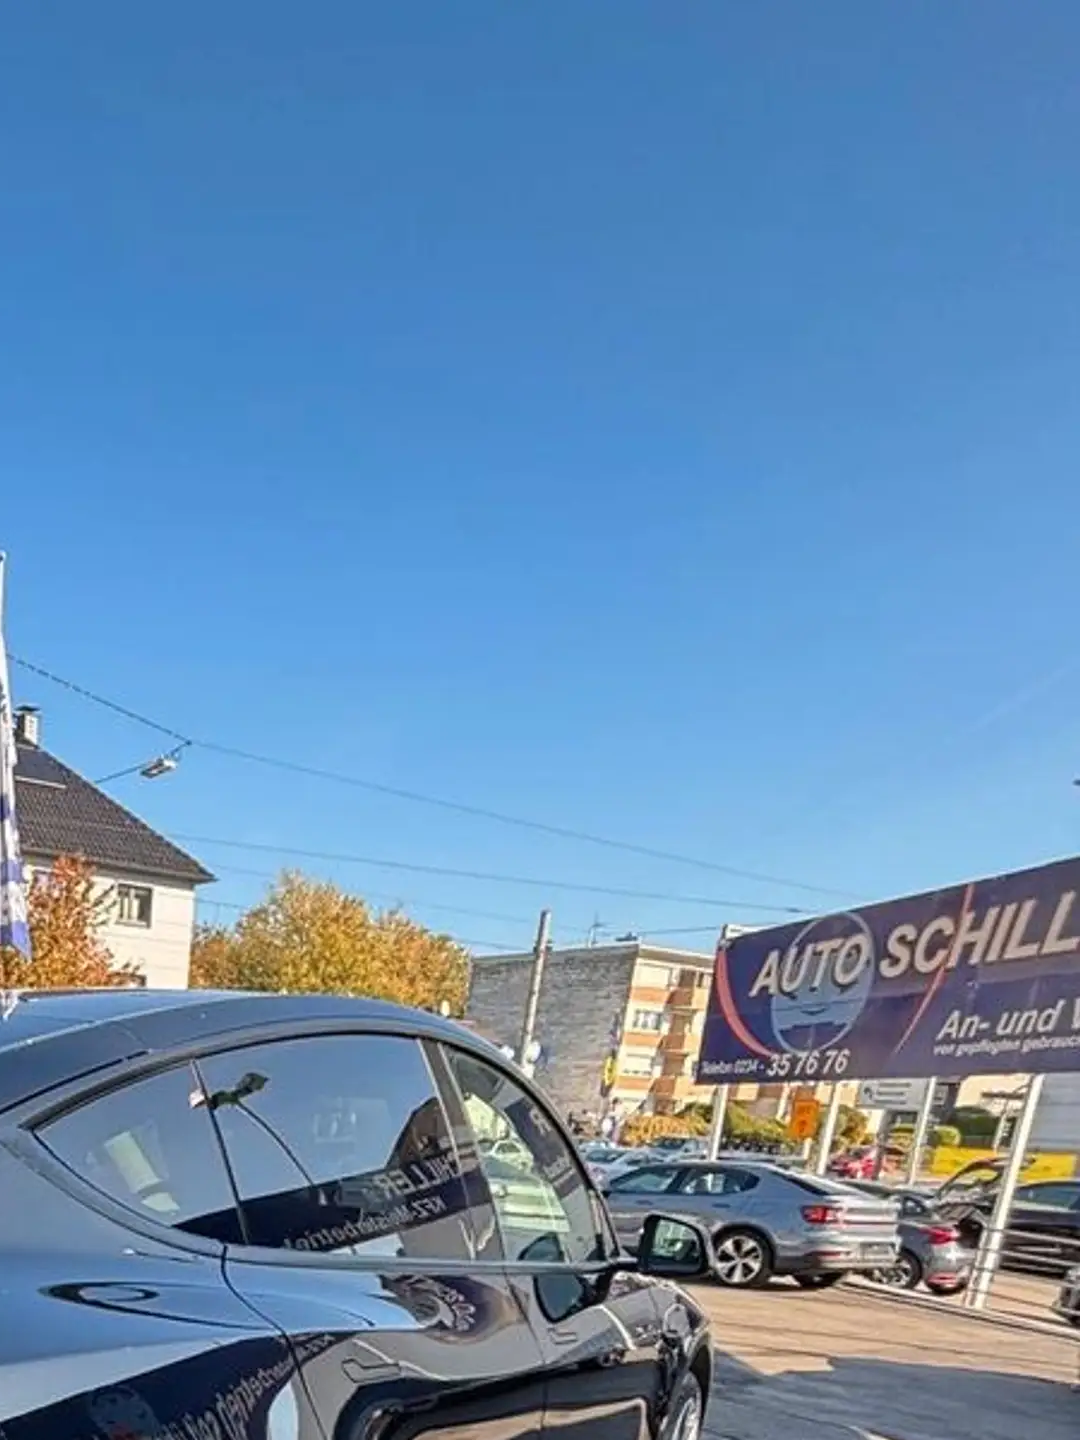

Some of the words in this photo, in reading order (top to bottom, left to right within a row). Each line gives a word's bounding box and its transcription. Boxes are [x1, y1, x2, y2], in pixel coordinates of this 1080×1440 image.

[749, 934, 870, 998] AUTO
[935, 1009, 991, 1041] An-
[996, 998, 1067, 1036] und
[767, 1053, 793, 1077] 35
[794, 1050, 820, 1077] 76
[822, 1048, 851, 1075] 76
